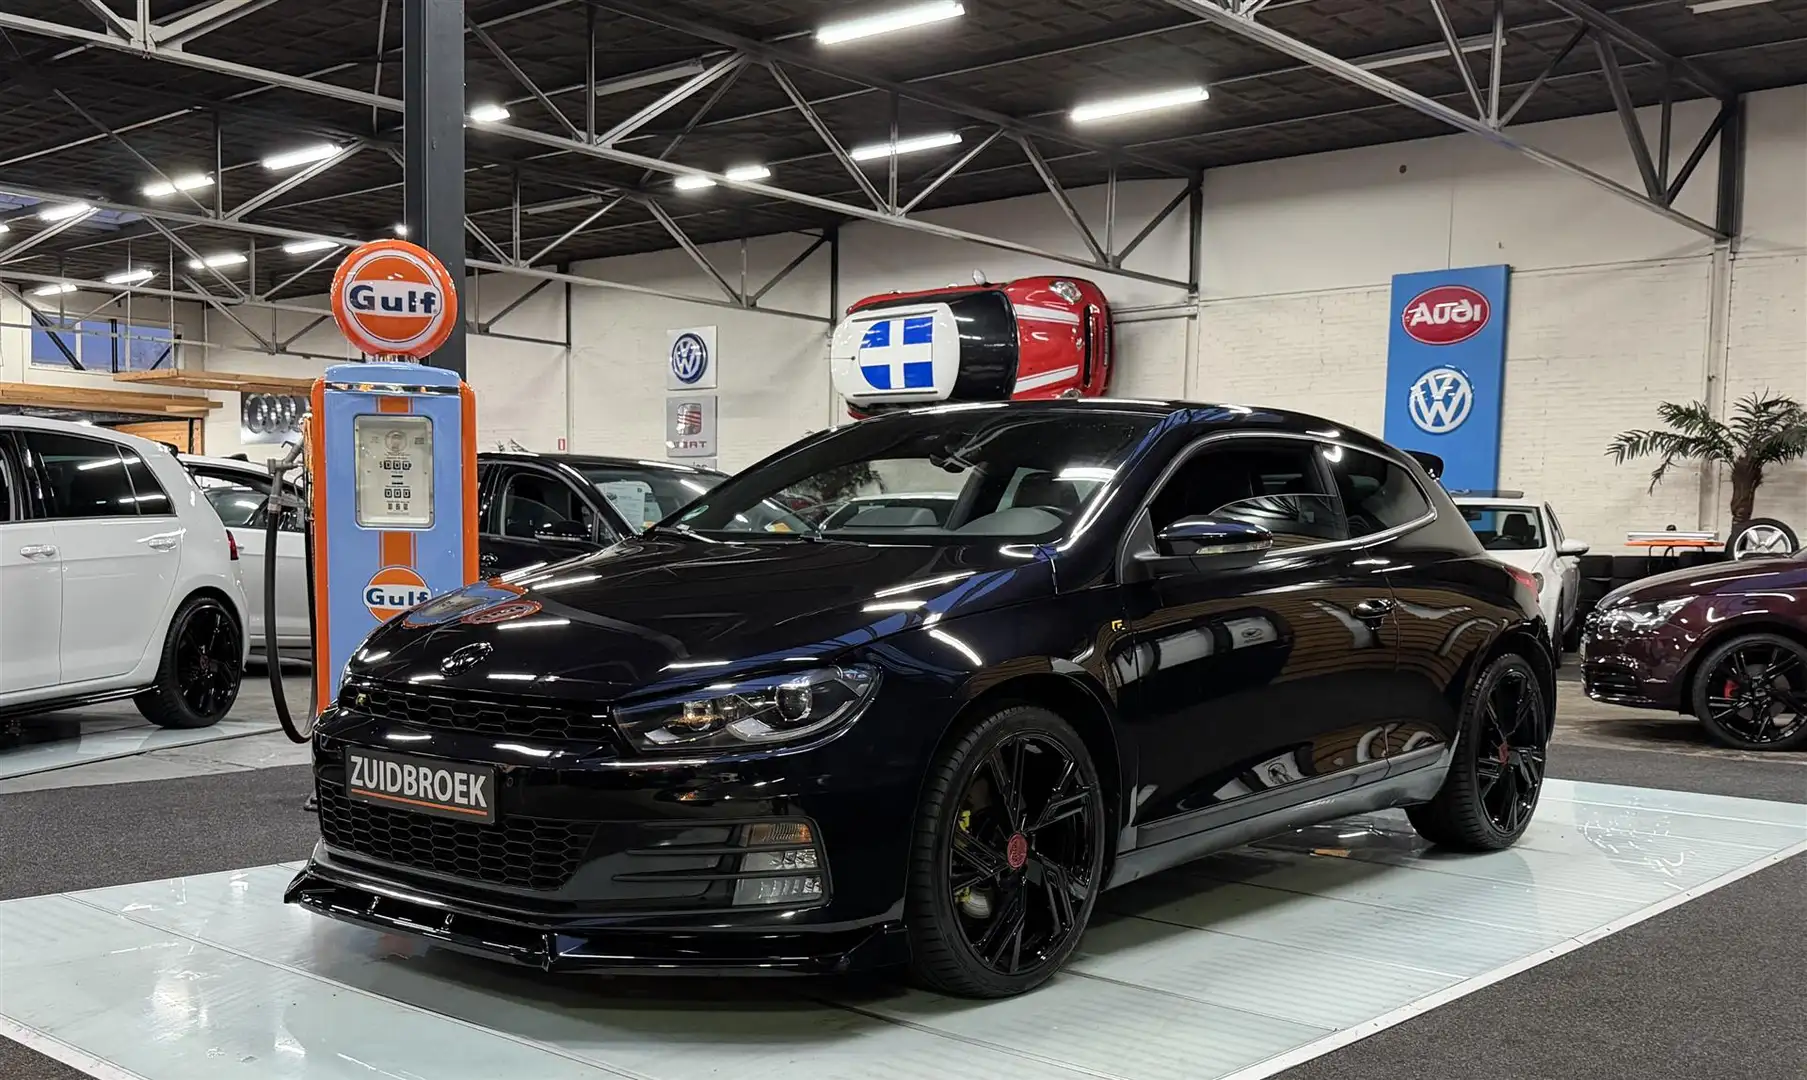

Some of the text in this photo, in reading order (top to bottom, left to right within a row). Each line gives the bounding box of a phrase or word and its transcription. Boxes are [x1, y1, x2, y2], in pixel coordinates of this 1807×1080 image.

[350, 285, 436, 313] Gulf
[366, 587, 429, 606] Gulf
[351, 755, 488, 808] ZUIDBROEK
